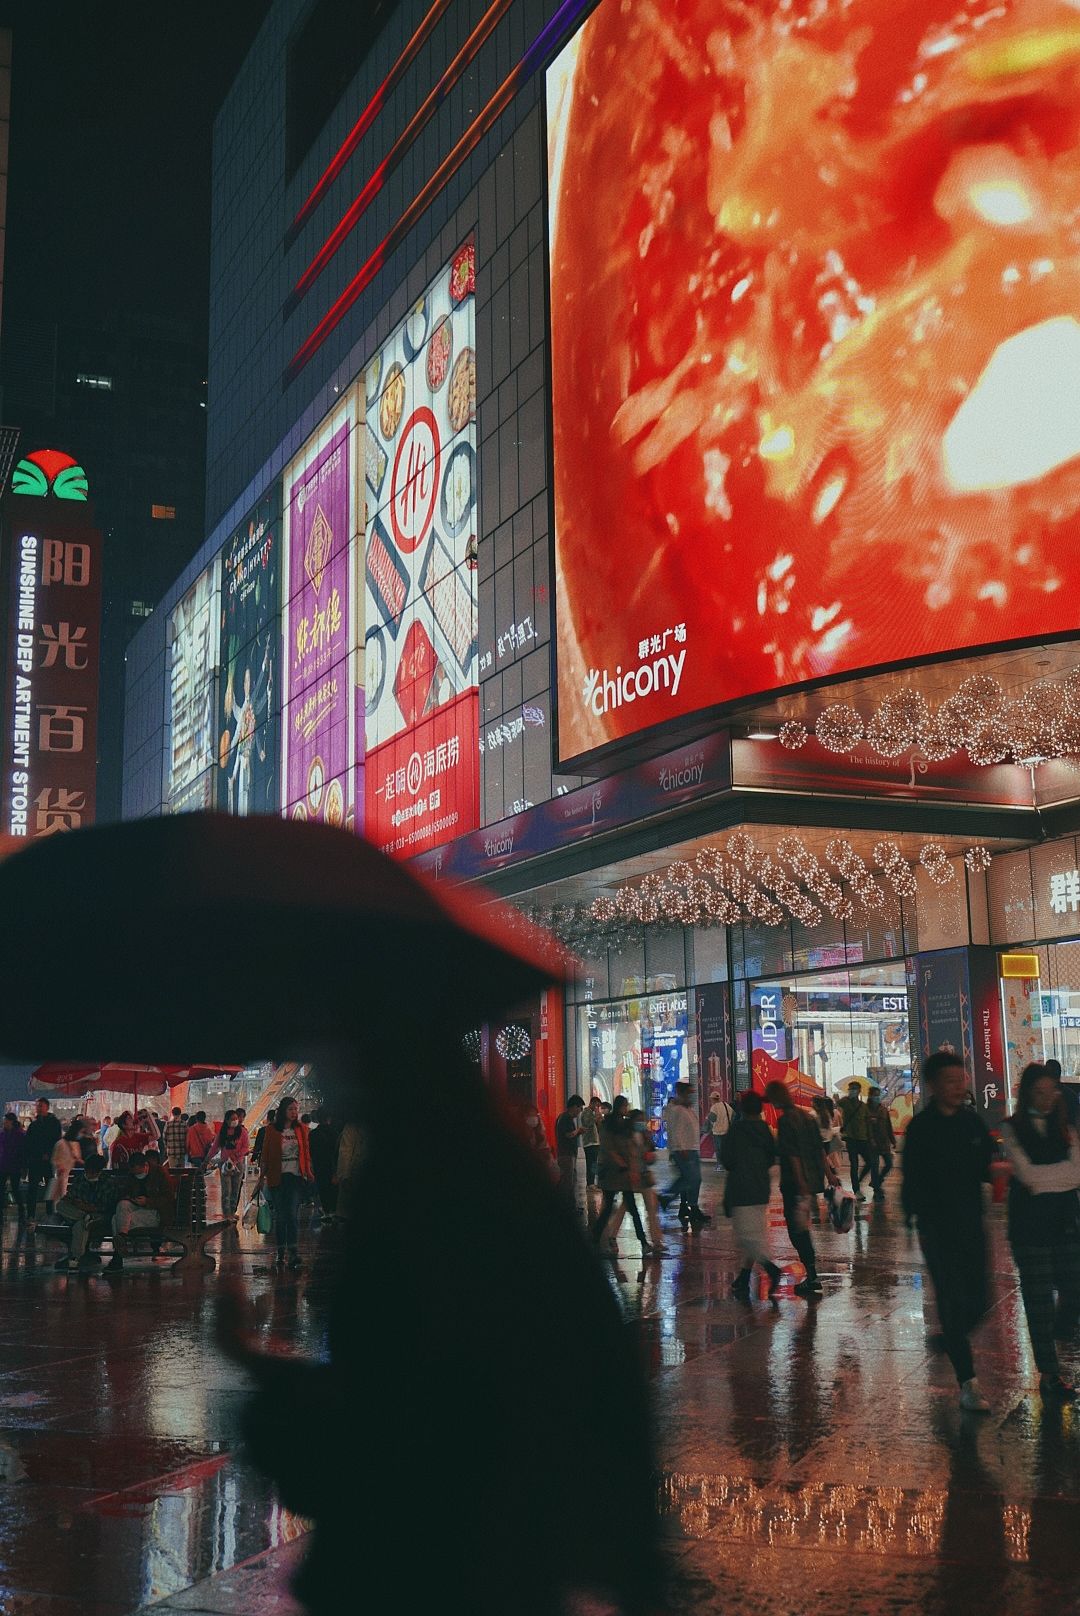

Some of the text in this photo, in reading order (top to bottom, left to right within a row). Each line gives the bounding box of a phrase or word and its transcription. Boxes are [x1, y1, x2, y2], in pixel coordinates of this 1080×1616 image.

[18, 535, 37, 630] SUNSHINE
[638, 622, 687, 660] 群光广场
[33, 538, 91, 837] 阳光百货
[591, 649, 687, 716] chicony
[423, 735, 460, 782] 海底捞
[662, 762, 704, 791] chicony
[849, 754, 863, 764] The
[865, 755, 890, 768] history
[10, 771, 29, 836] STORE
[1050, 870, 1080, 914] 群
[761, 994, 778, 1059] UDER
[984, 1028, 992, 1060] history
[986, 1061, 994, 1072] of
